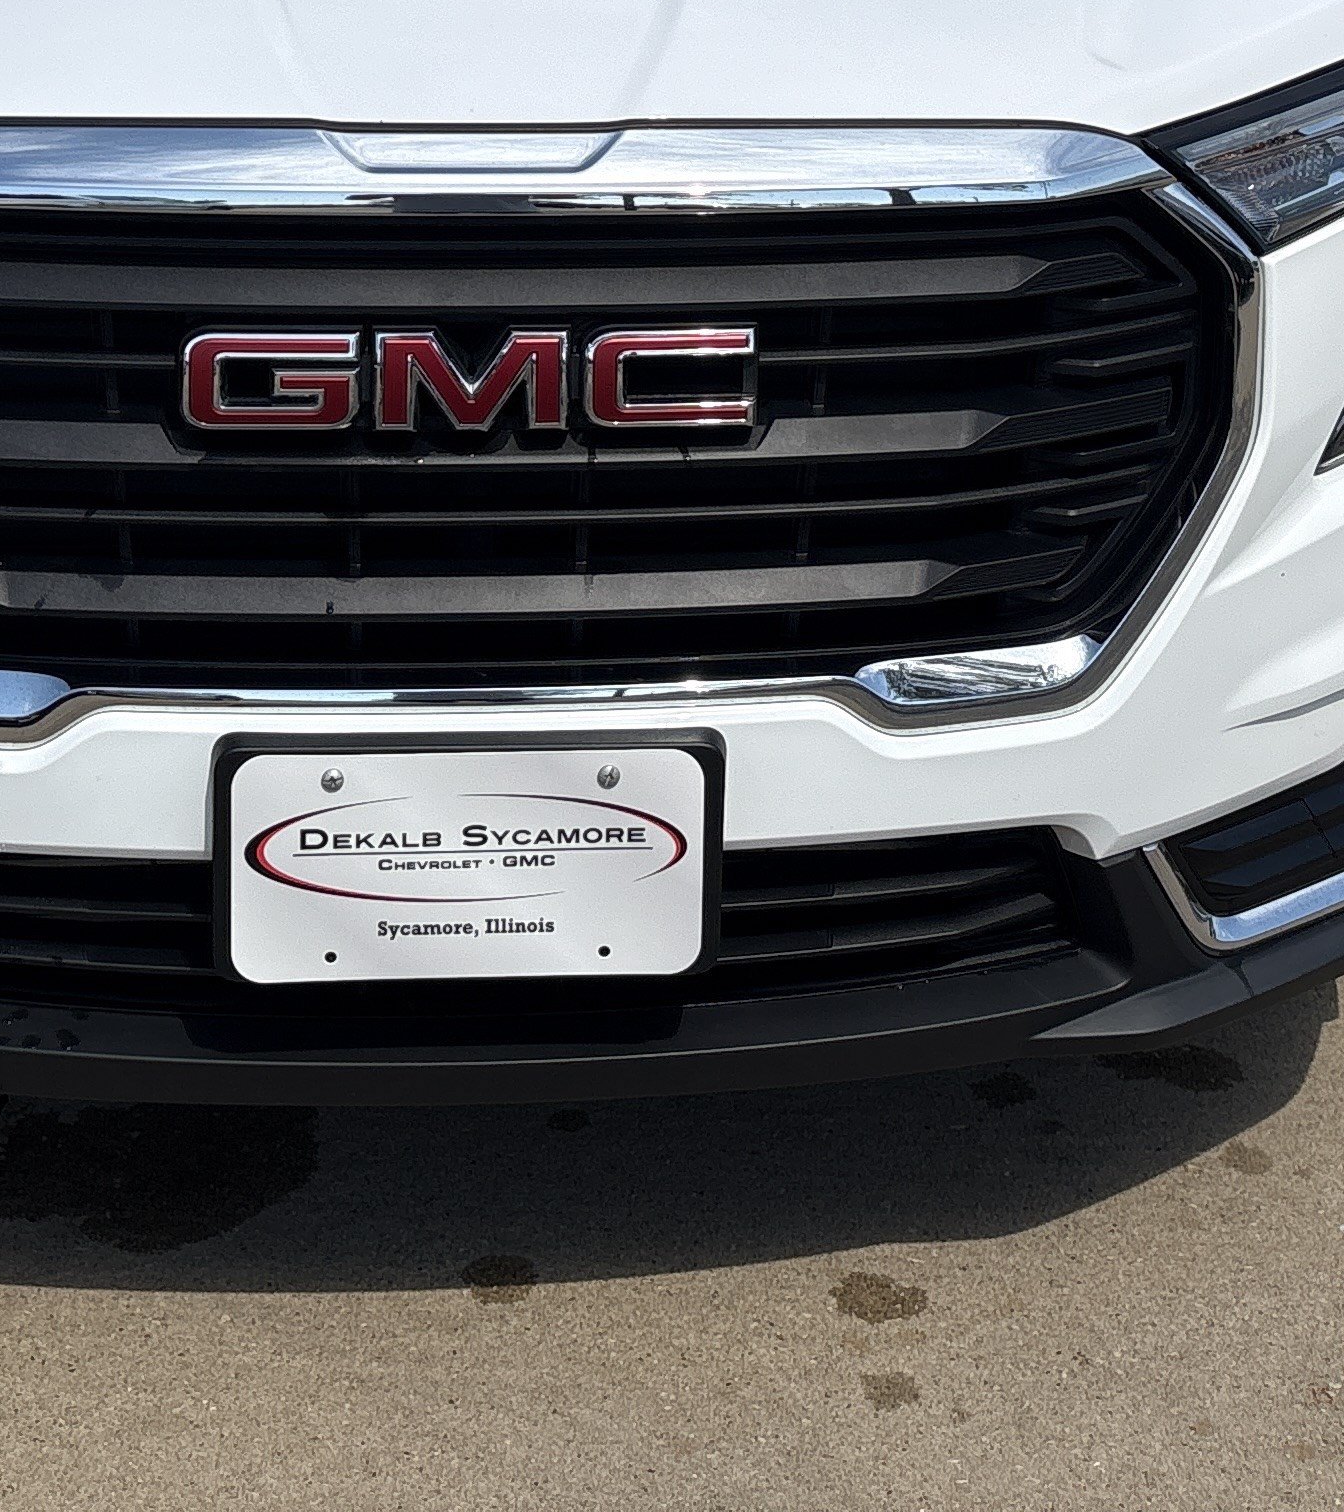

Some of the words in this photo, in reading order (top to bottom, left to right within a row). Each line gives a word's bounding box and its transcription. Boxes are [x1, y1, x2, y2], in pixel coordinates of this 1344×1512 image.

[182, 326, 756, 430] GMC
[299, 828, 442, 850] DEKALB
[462, 824, 648, 847] SYCAMORE
[378, 858, 483, 871] CHEVROLET
[502, 854, 556, 868] GMC
[377, 920, 479, 941] Sycamore,
[484, 917, 555, 934] Illinois
